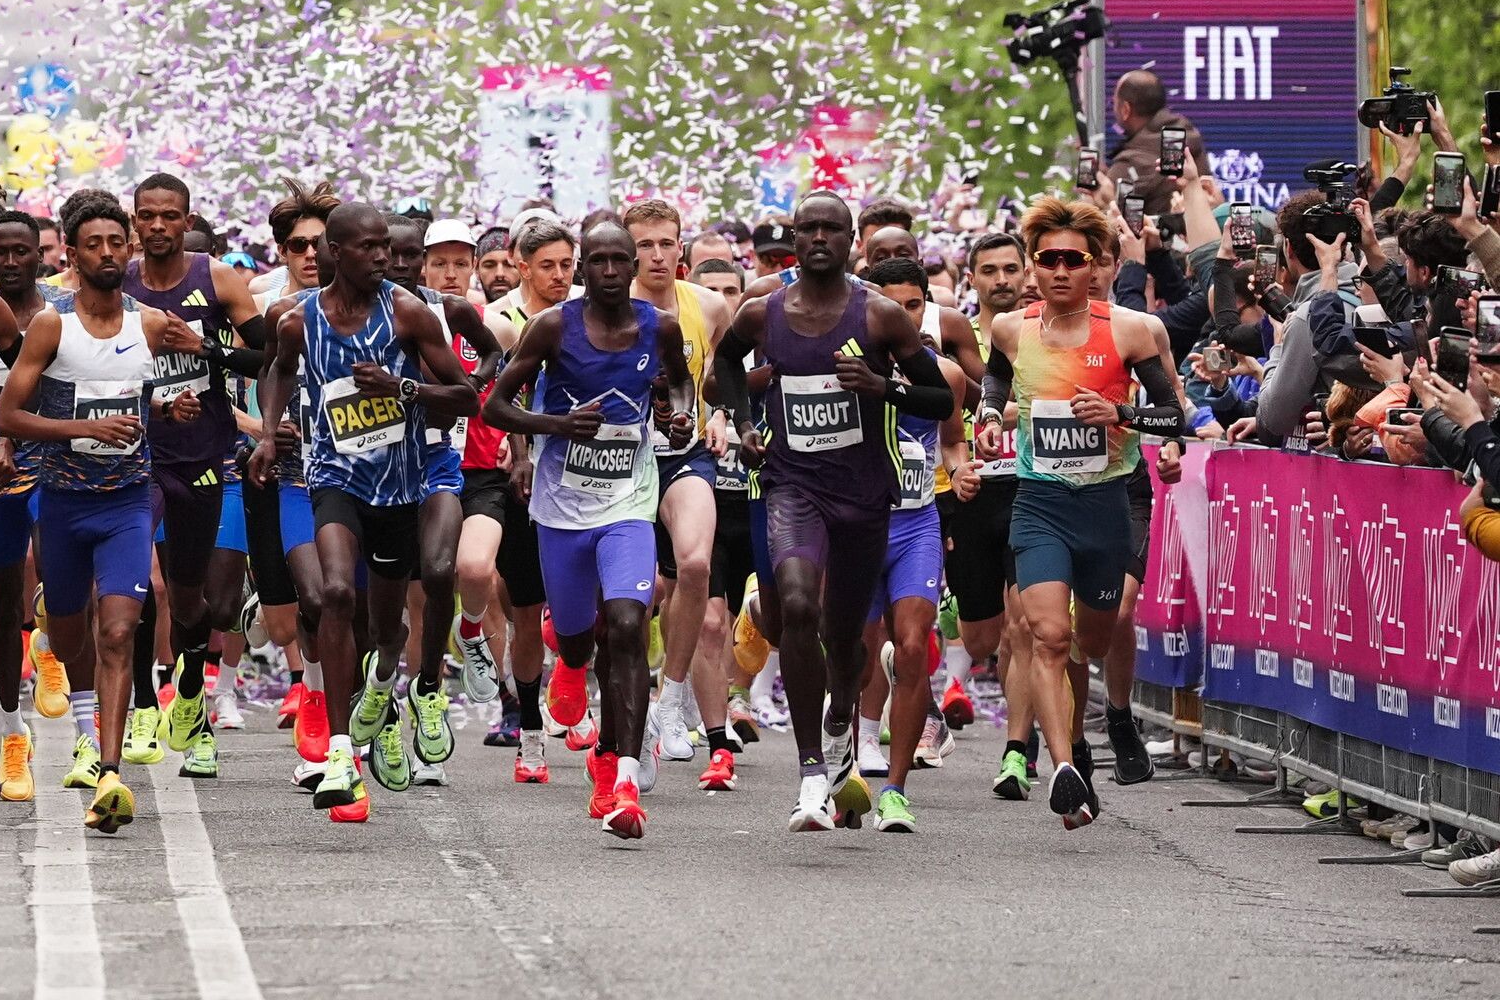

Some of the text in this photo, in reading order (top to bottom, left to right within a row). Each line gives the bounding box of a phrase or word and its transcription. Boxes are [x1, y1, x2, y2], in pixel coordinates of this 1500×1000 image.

[1184, 26, 1280, 101] FIAT
[331, 396, 403, 436] PACER
[792, 400, 850, 428] SUGUT
[1143, 416, 1178, 427] RUNNING
[367, 432, 388, 444] asics
[816, 435, 838, 445] asics
[1040, 426, 1099, 451] WANG
[569, 443, 635, 472] KIPKOSGEI
[1063, 459, 1084, 468] asics
[592, 479, 612, 489] asics
